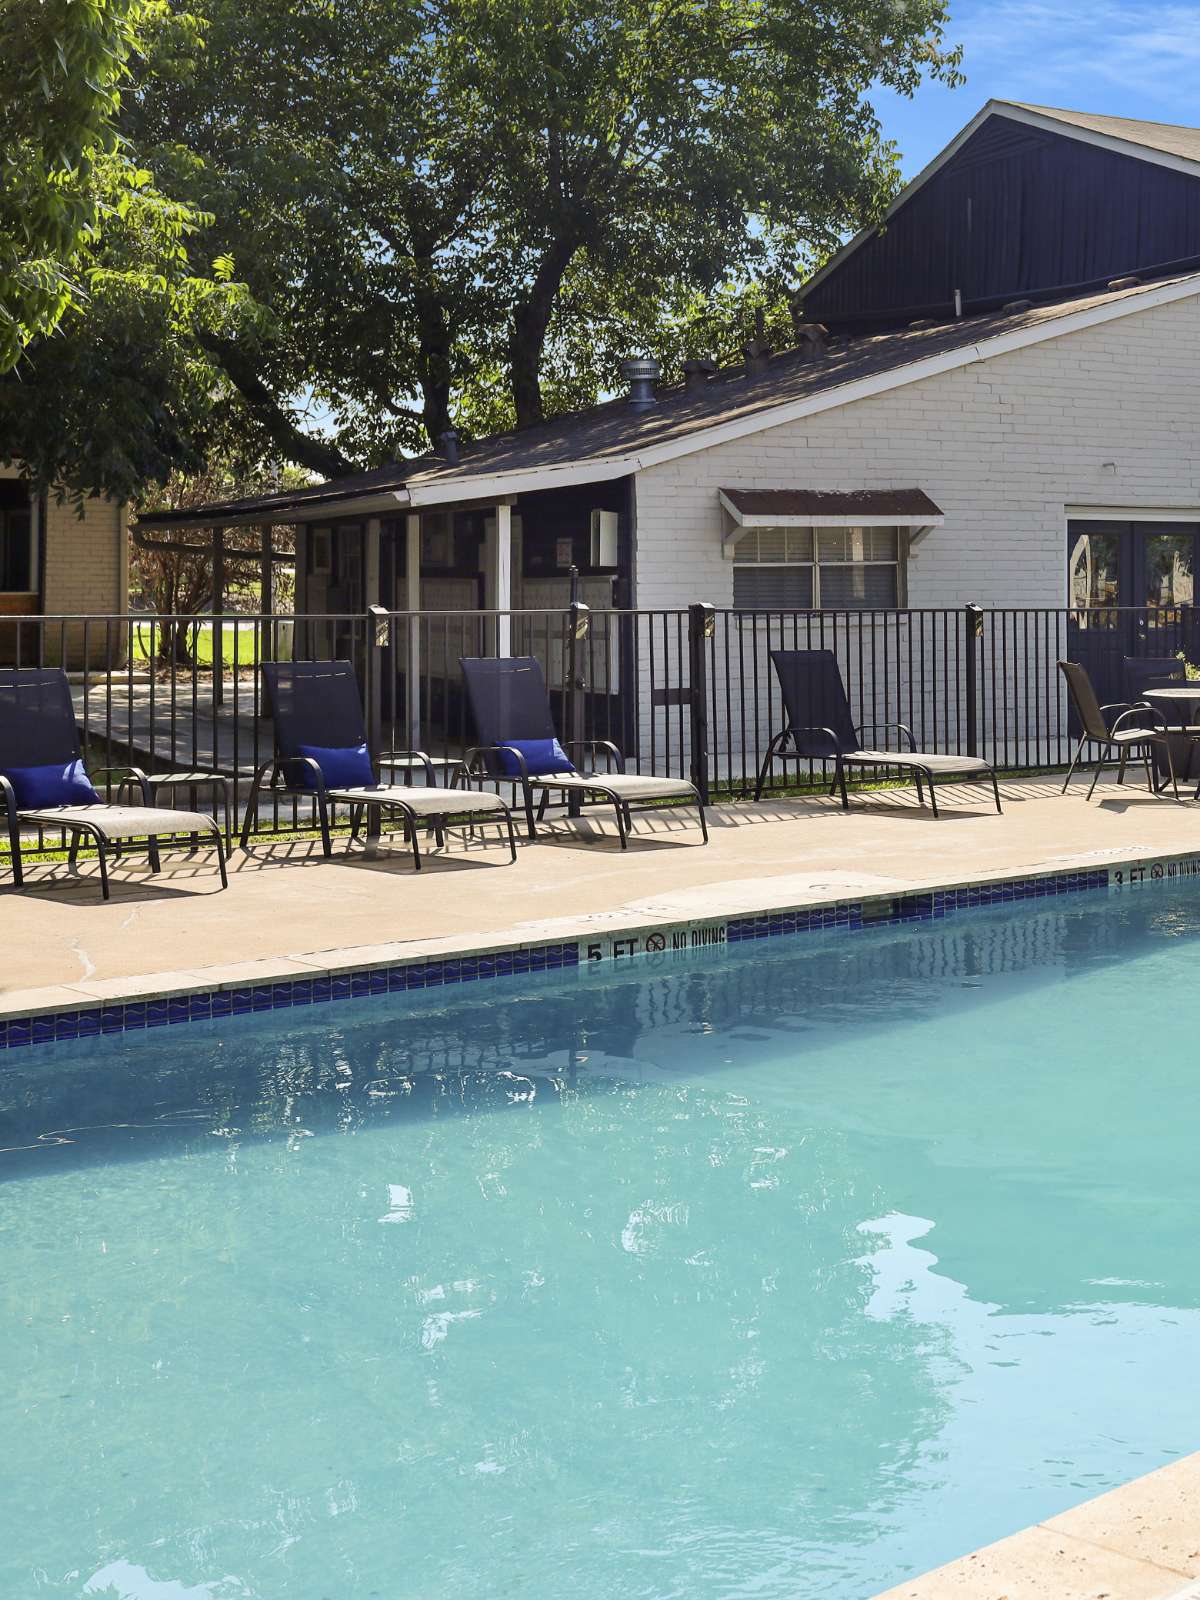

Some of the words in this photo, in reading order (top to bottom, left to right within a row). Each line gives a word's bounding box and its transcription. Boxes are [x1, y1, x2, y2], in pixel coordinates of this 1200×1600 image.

[1114, 870, 1123, 884] 3
[1129, 867, 1146, 882] FT
[1167, 862, 1177, 877] NO
[587, 943, 602, 961] 5
[613, 938, 639, 958] FT
[672, 931, 687, 950] NO
[691, 926, 726, 948] DIVING
